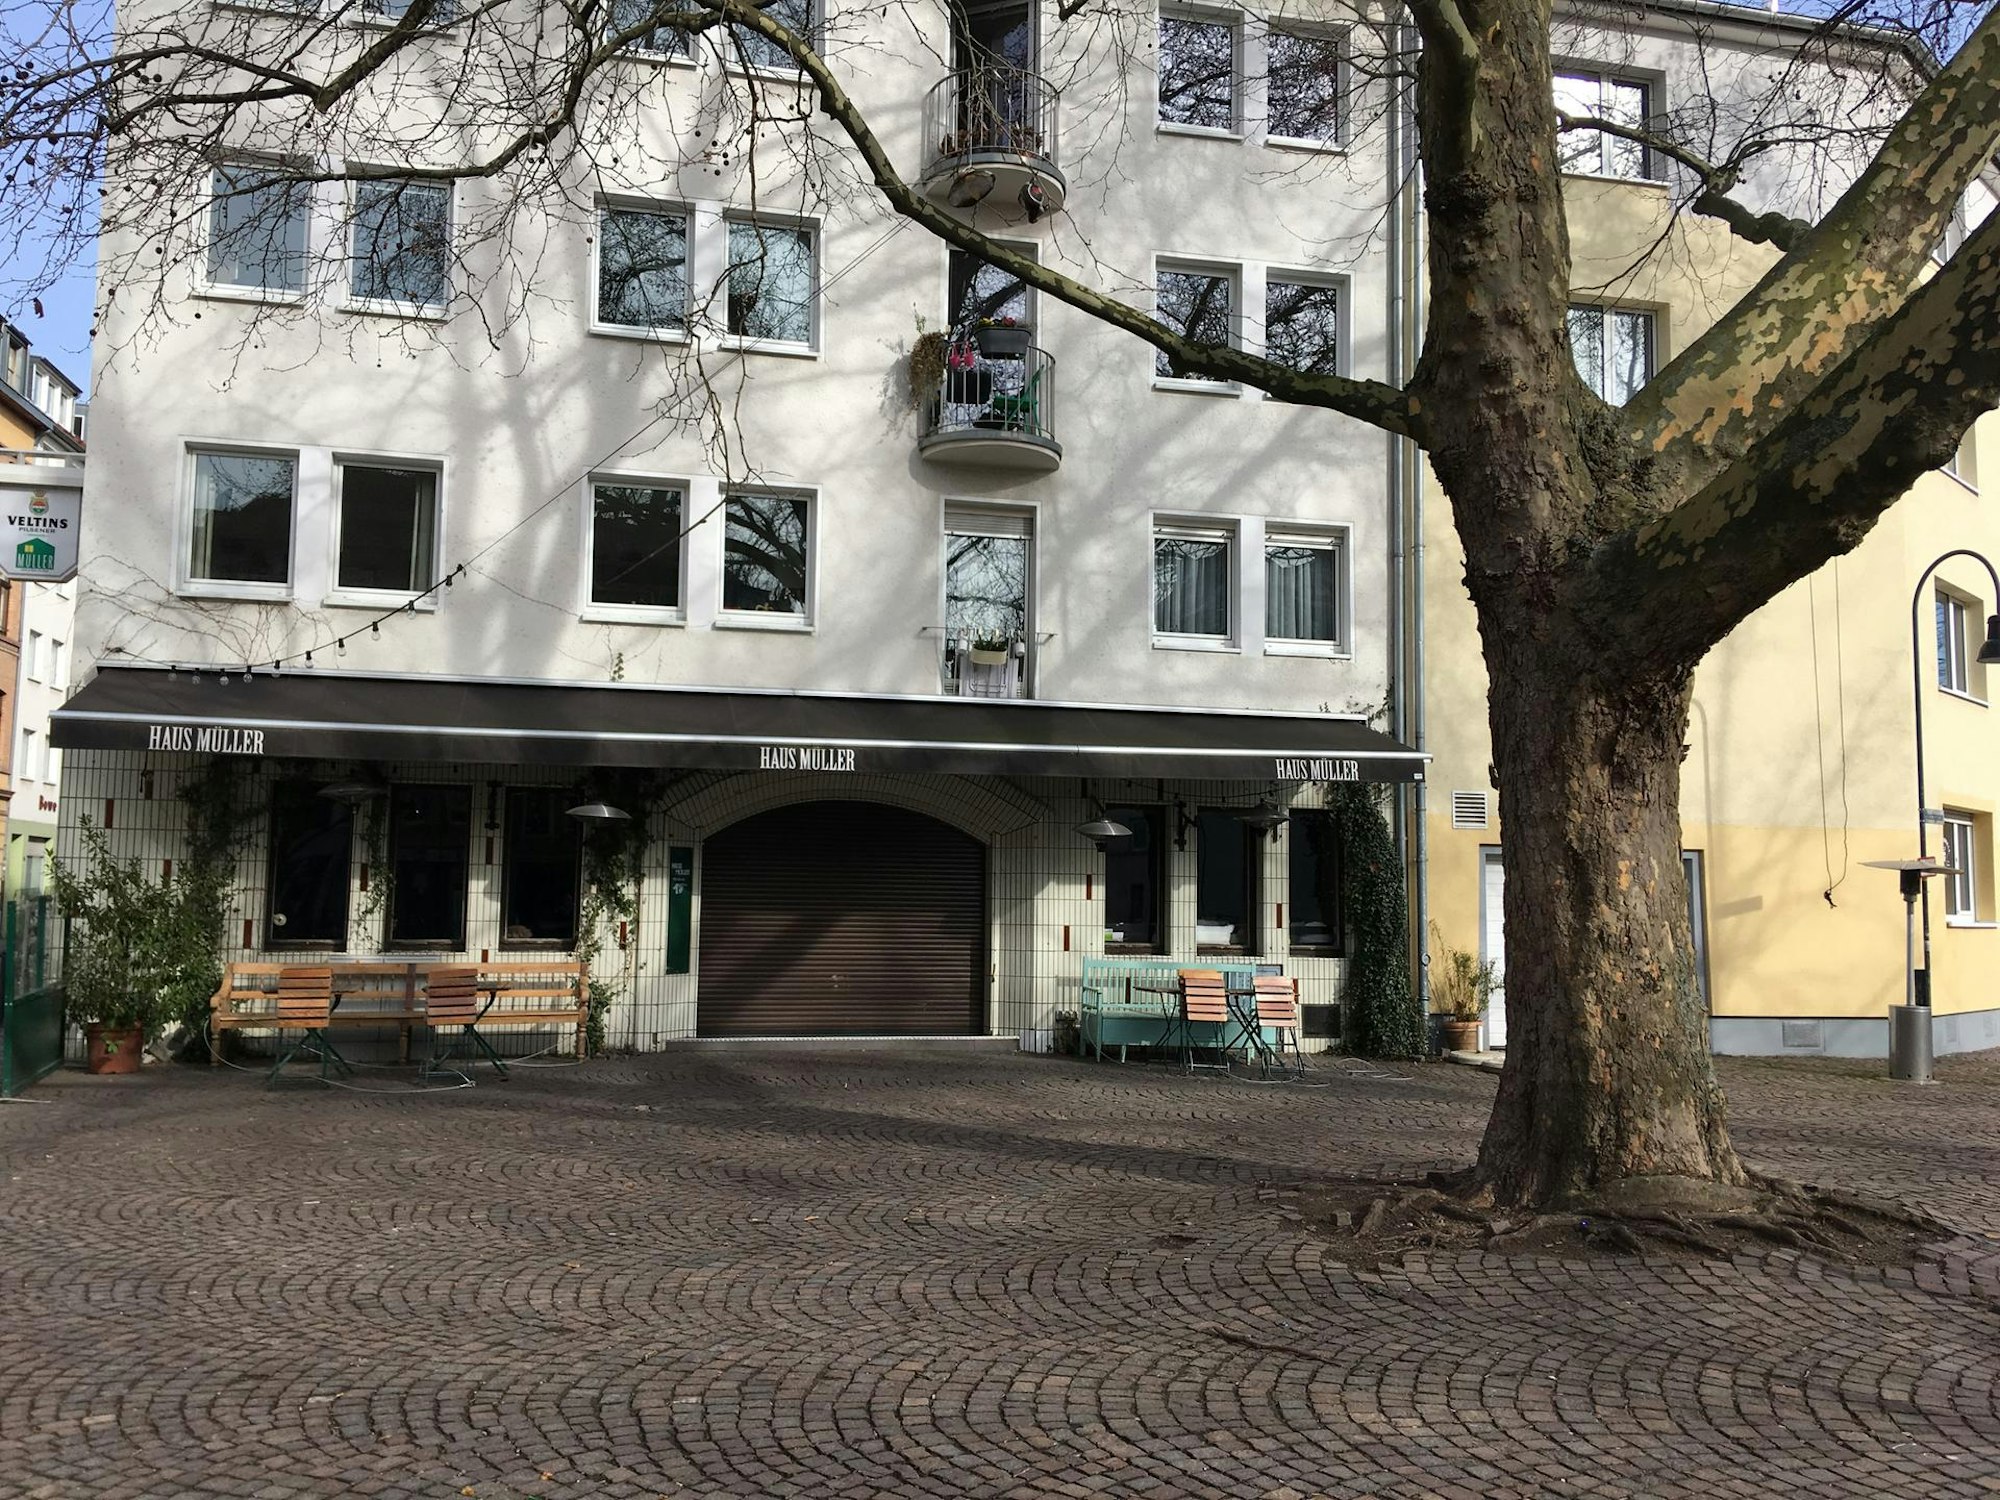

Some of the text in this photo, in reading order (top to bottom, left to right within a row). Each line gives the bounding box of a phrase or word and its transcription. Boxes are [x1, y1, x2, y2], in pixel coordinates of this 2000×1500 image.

[7, 515, 68, 529] VELTINS
[148, 725, 265, 755] HAUS MÜLLER
[760, 746, 797, 770] HAUS
[1275, 757, 1360, 782] HAUS MÜLLER
